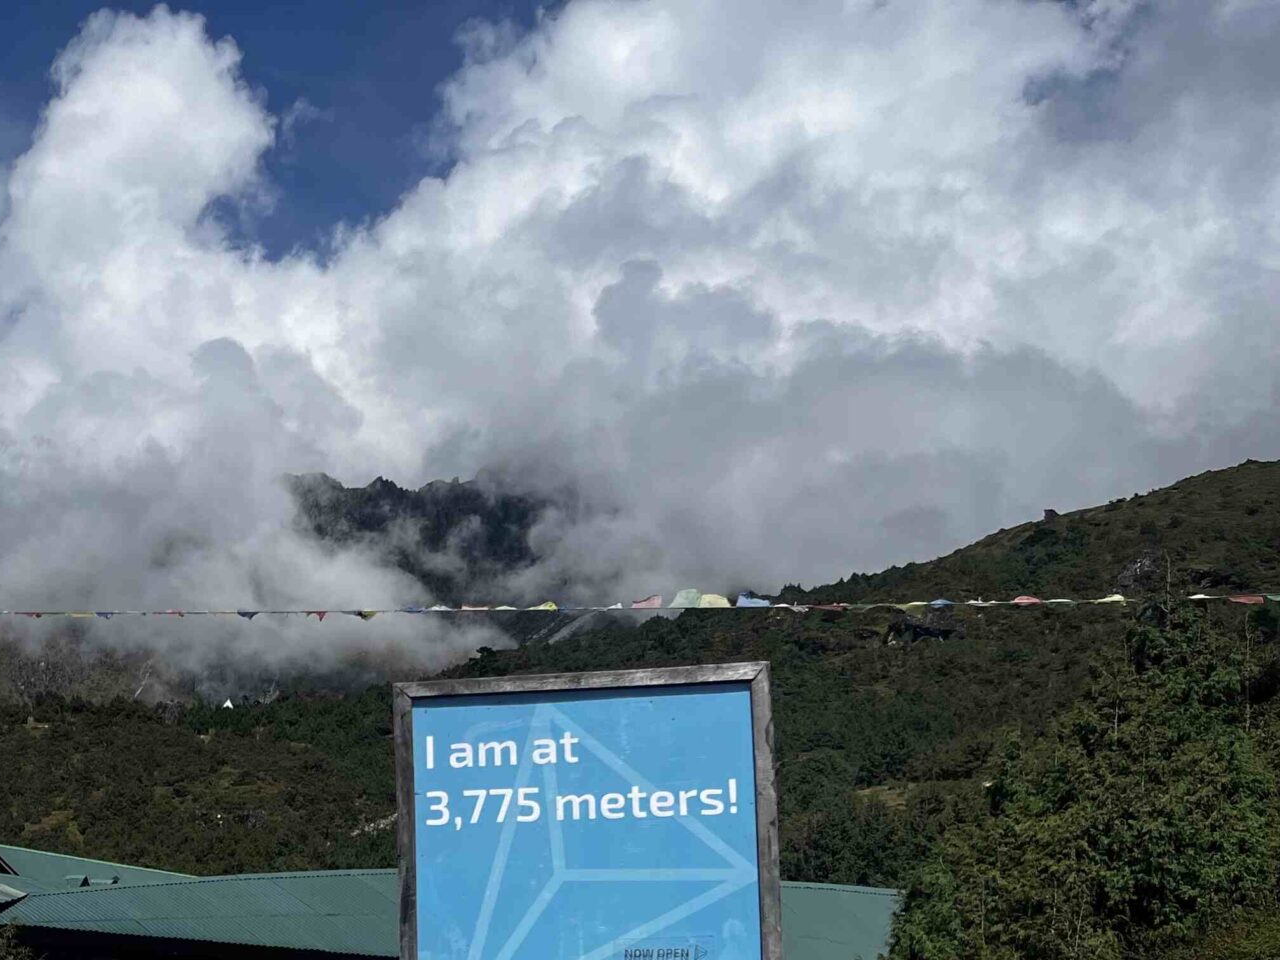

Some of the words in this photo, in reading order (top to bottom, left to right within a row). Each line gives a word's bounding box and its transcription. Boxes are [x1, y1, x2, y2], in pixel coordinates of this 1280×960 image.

[425, 735, 434, 770] I
[449, 739, 518, 768] am
[532, 731, 580, 765] at
[425, 786, 541, 831] 3,775
[556, 778, 738, 822] meters!
